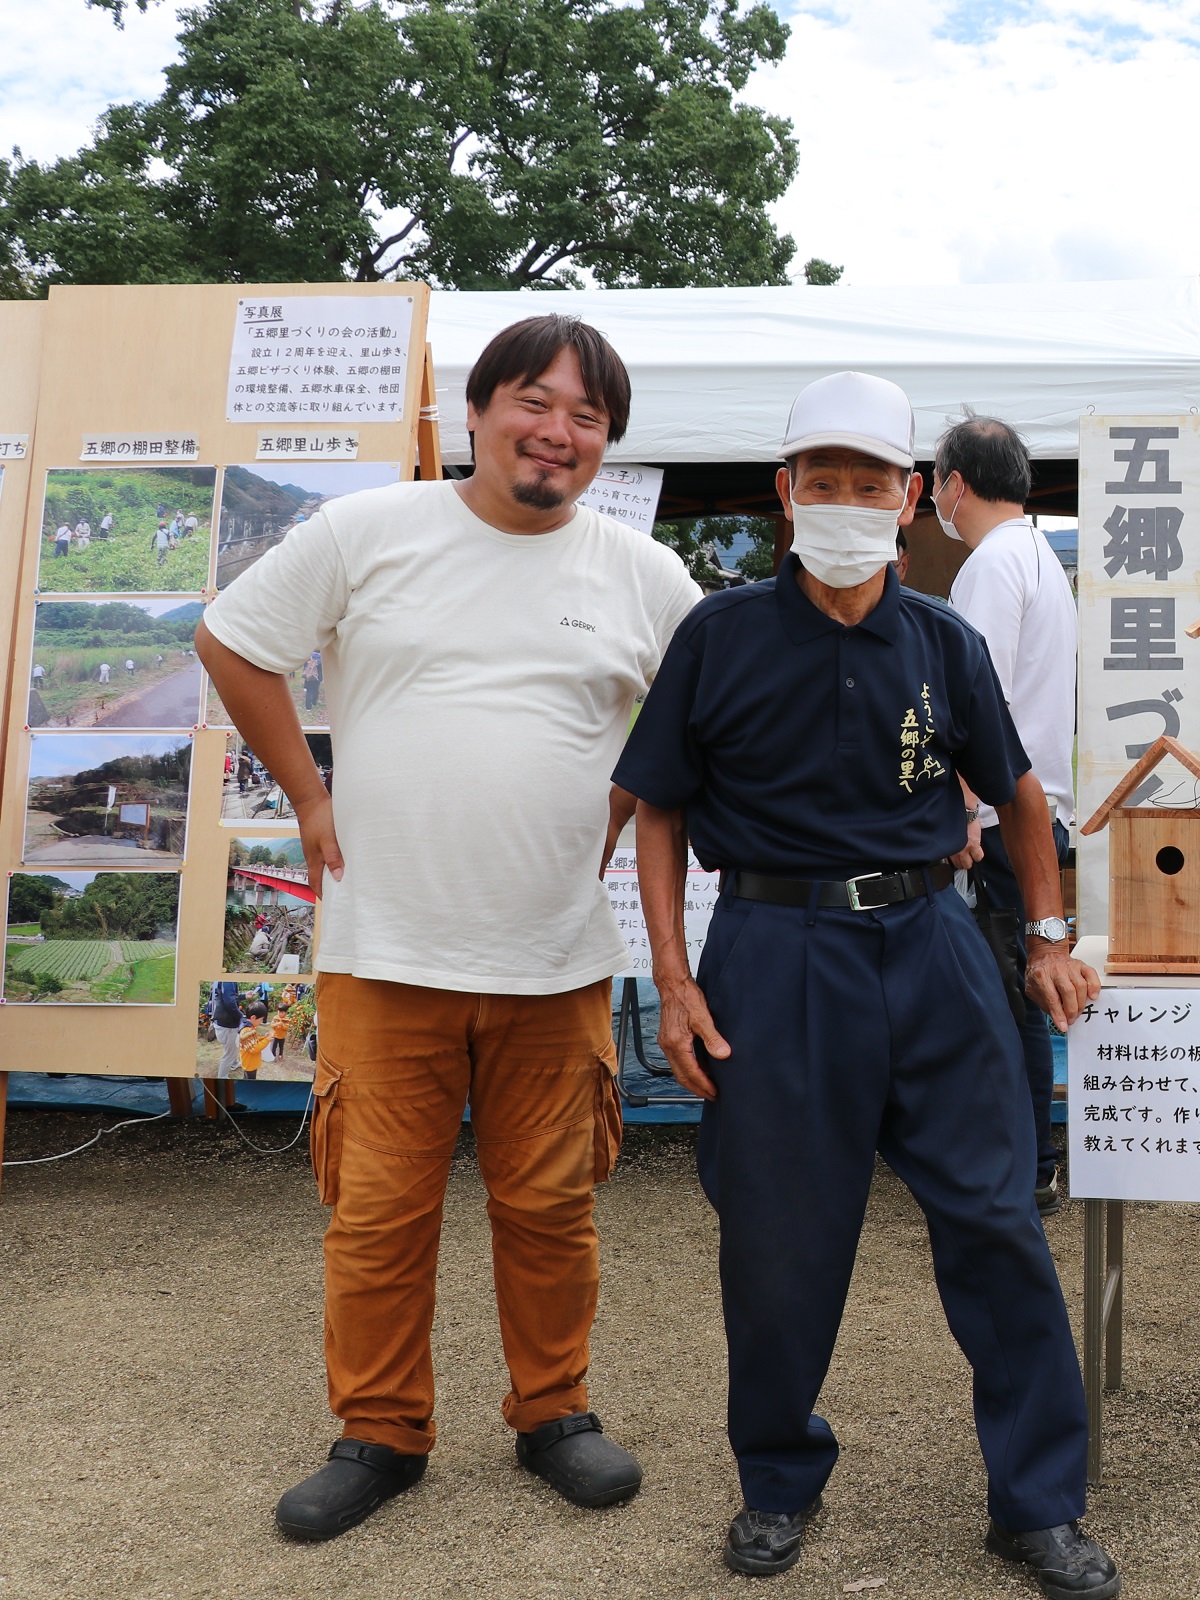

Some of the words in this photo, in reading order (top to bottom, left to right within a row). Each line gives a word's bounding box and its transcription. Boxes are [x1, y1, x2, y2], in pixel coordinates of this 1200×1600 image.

[244, 305, 283, 319] 写真展
[247, 326, 399, 339] 「五郷里づくりの会の活動」
[236, 365, 401, 376] 五郷ピザづくり体験、五郷の棚田
[235, 383, 399, 394] の環境整備、五郷水車保全、他団
[233, 402, 402, 413] 体との交流等に取り組んでいます。
[84, 440, 197, 455] 五郷の棚田整備
[259, 437, 357, 452] 五郷里山歩き
[921, 683, 935, 748] ようこそ
[899, 708, 919, 793] 五郷の里へ
